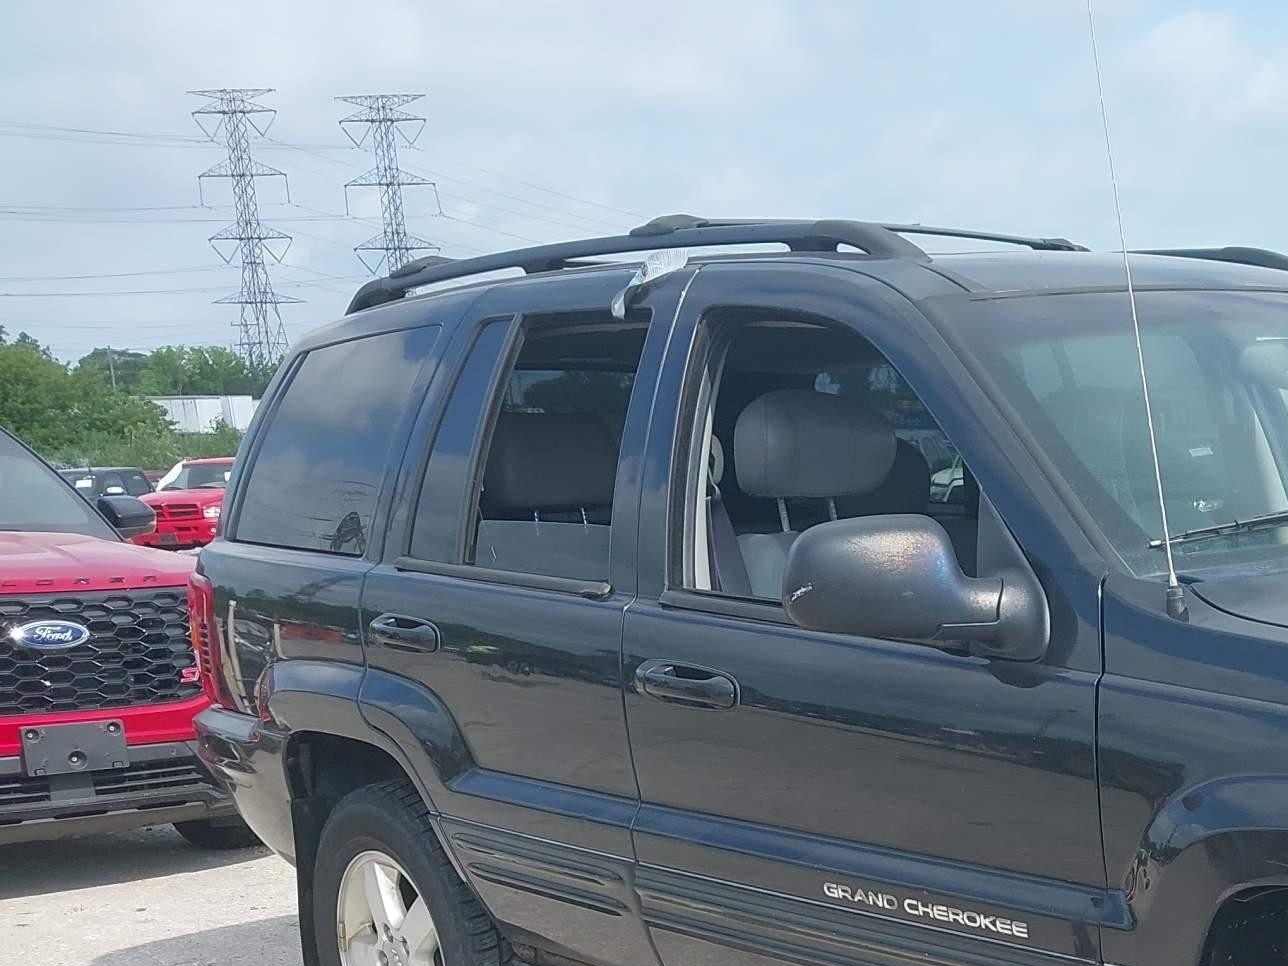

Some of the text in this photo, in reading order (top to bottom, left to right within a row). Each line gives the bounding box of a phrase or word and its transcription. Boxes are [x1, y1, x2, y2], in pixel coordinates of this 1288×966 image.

[33, 626, 74, 642] Ford
[823, 882, 1029, 938] GRAND CHEROKEE
